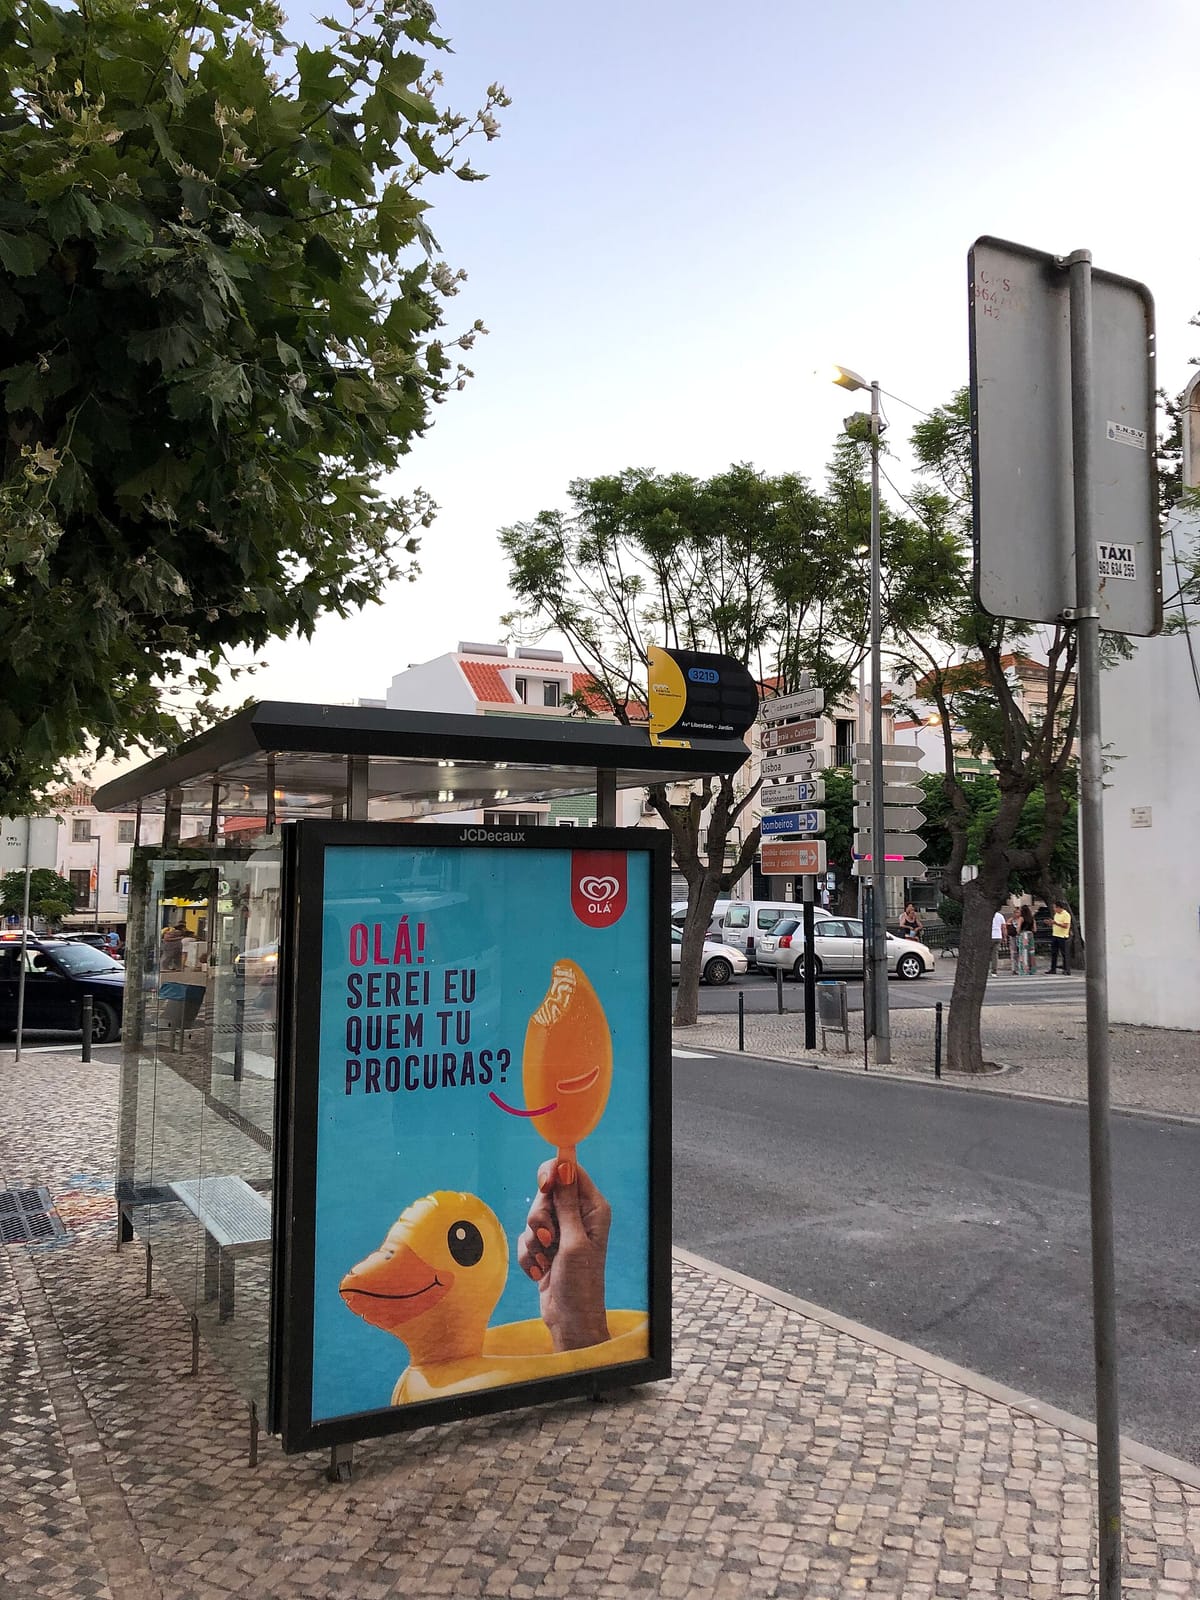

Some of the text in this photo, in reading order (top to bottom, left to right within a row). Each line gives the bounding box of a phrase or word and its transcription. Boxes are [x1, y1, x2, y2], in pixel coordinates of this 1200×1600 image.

[692, 669, 715, 681] 3219
[691, 721, 714, 730] Liberdade
[762, 763, 781, 773] Lisboa
[763, 819, 793, 830] bombeiros
[459, 828, 526, 842] JCDecaux
[588, 901, 611, 914] OLÁ
[349, 915, 426, 967] OLÁ!
[346, 968, 476, 1010] SEREI EU
[345, 1010, 471, 1056] QUEM TU
[345, 1048, 511, 1096] PROCURAS?
